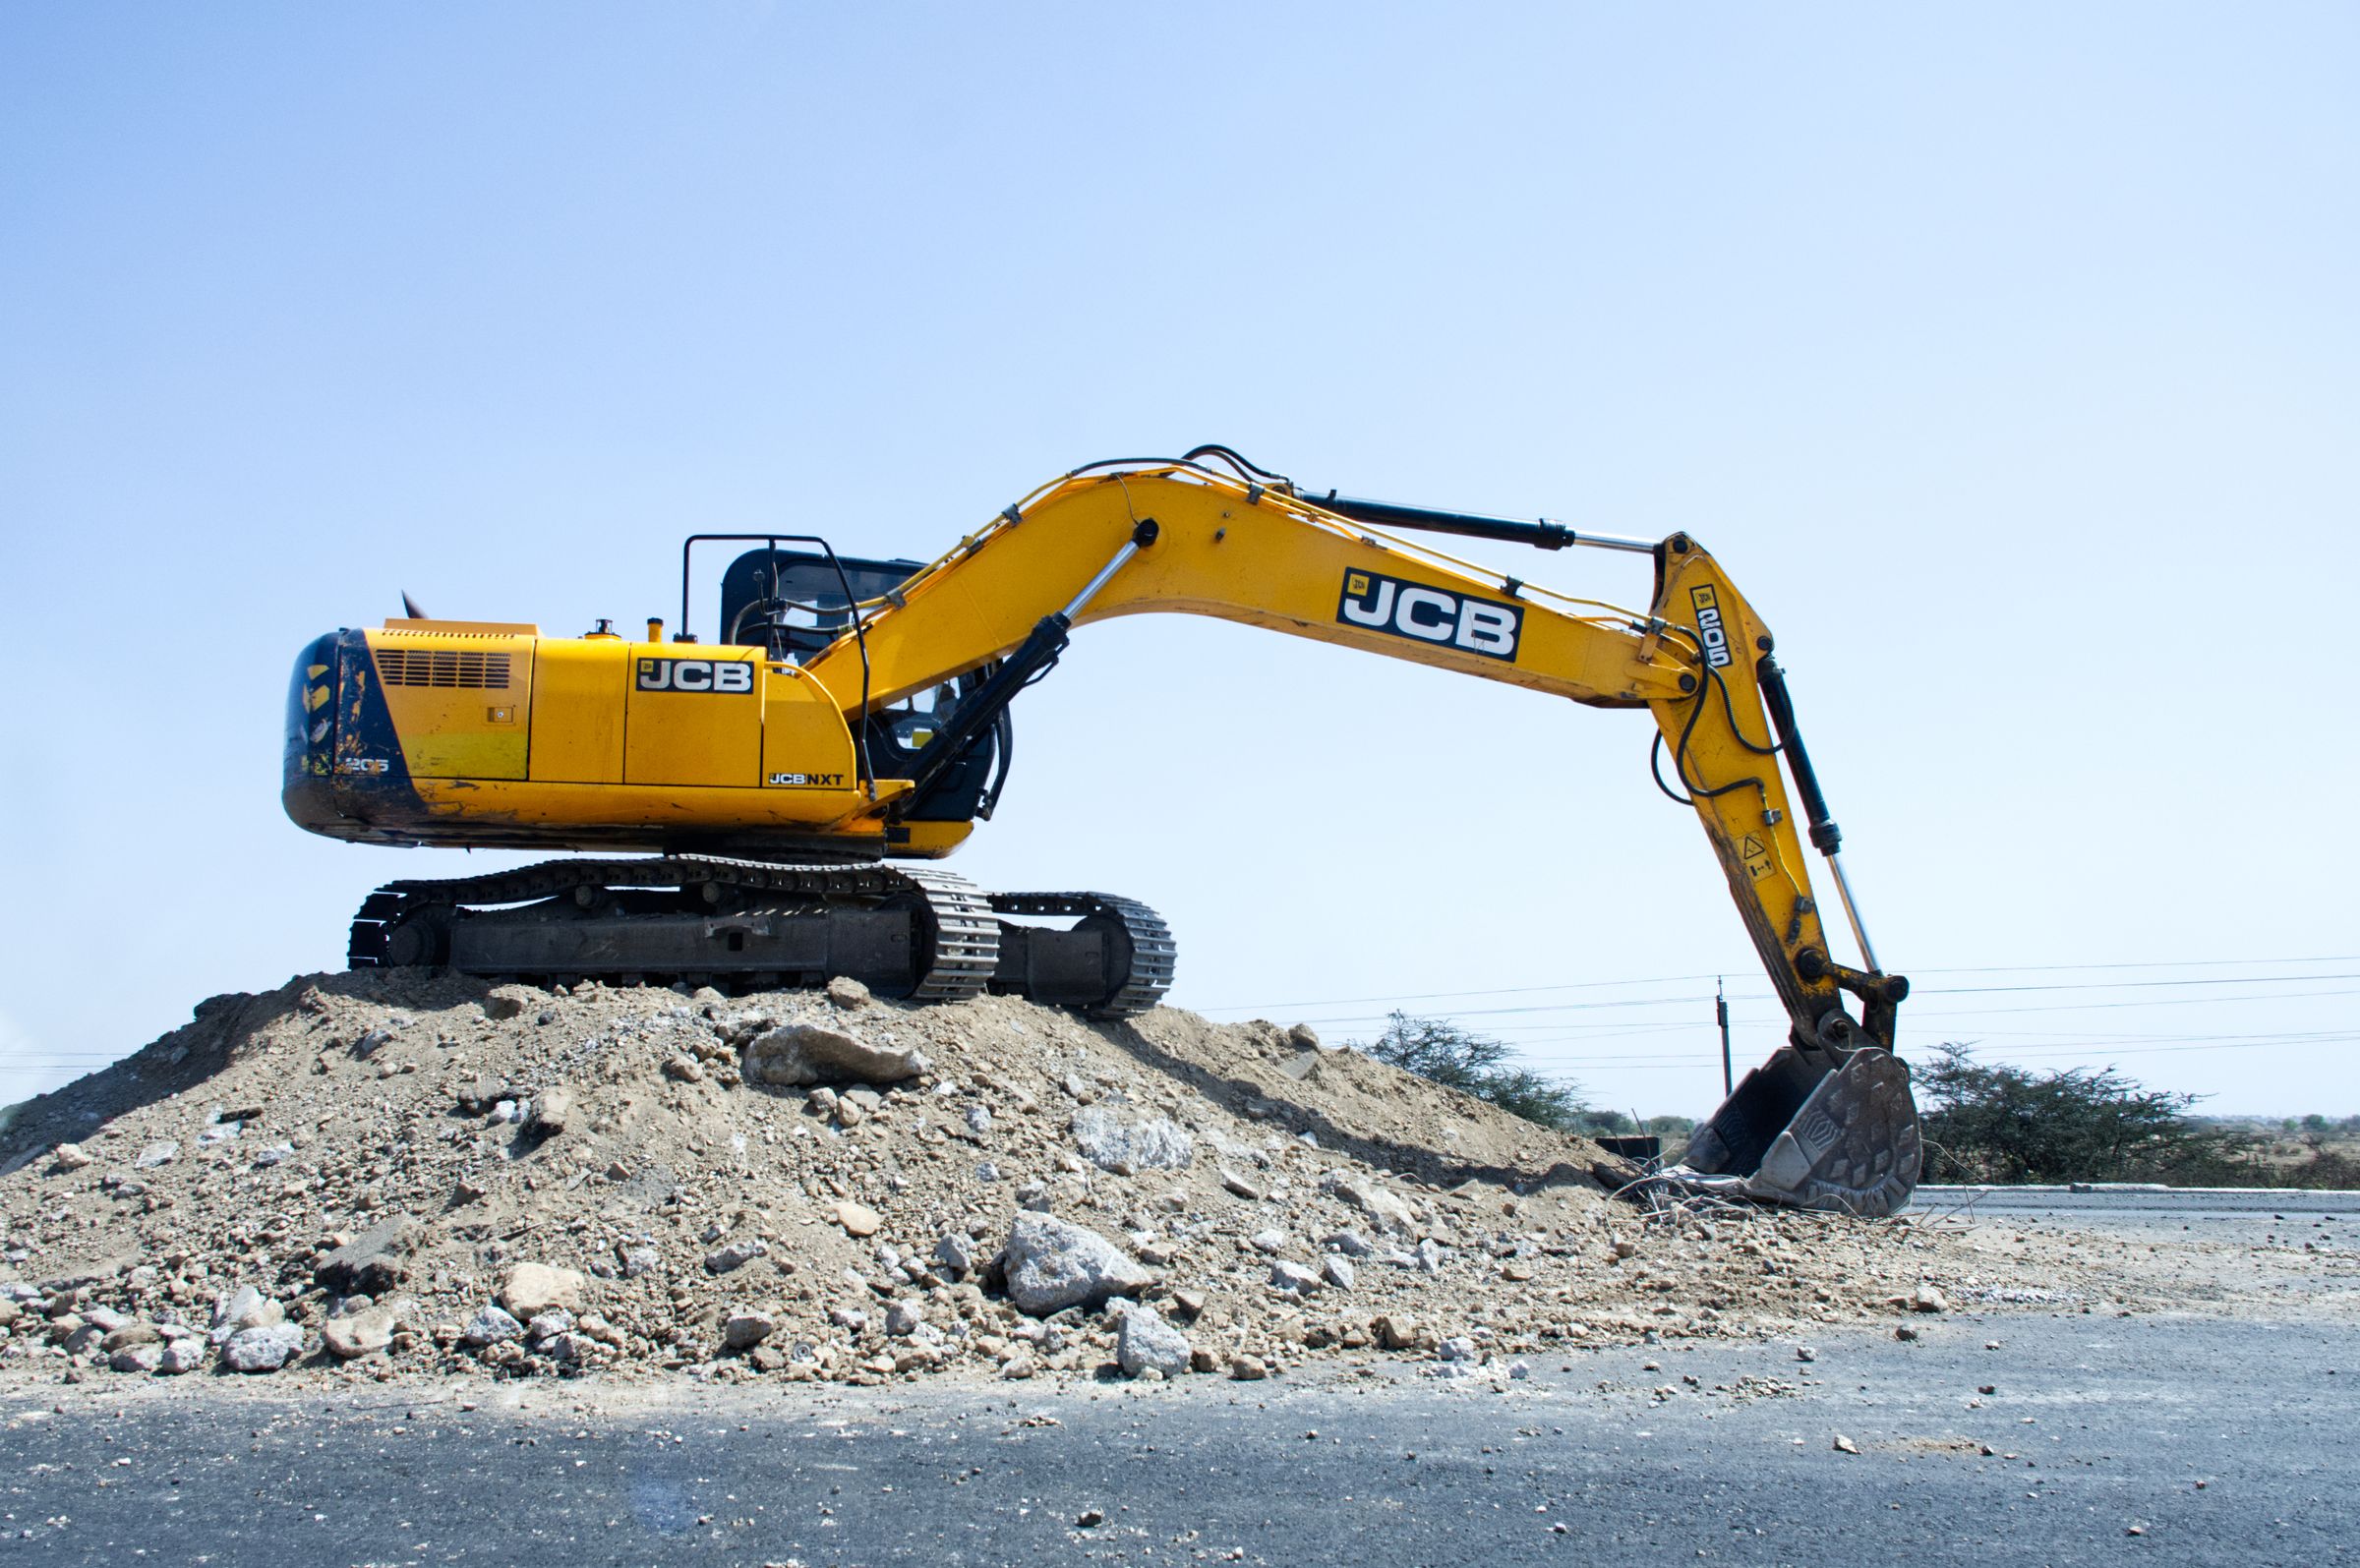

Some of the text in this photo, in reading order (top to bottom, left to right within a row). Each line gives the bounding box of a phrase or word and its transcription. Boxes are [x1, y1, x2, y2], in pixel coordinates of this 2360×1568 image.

[1343, 580, 1516, 656] JCB
[1697, 608, 1731, 668] 205
[640, 661, 751, 691] JCB
[345, 757, 389, 772] 205
